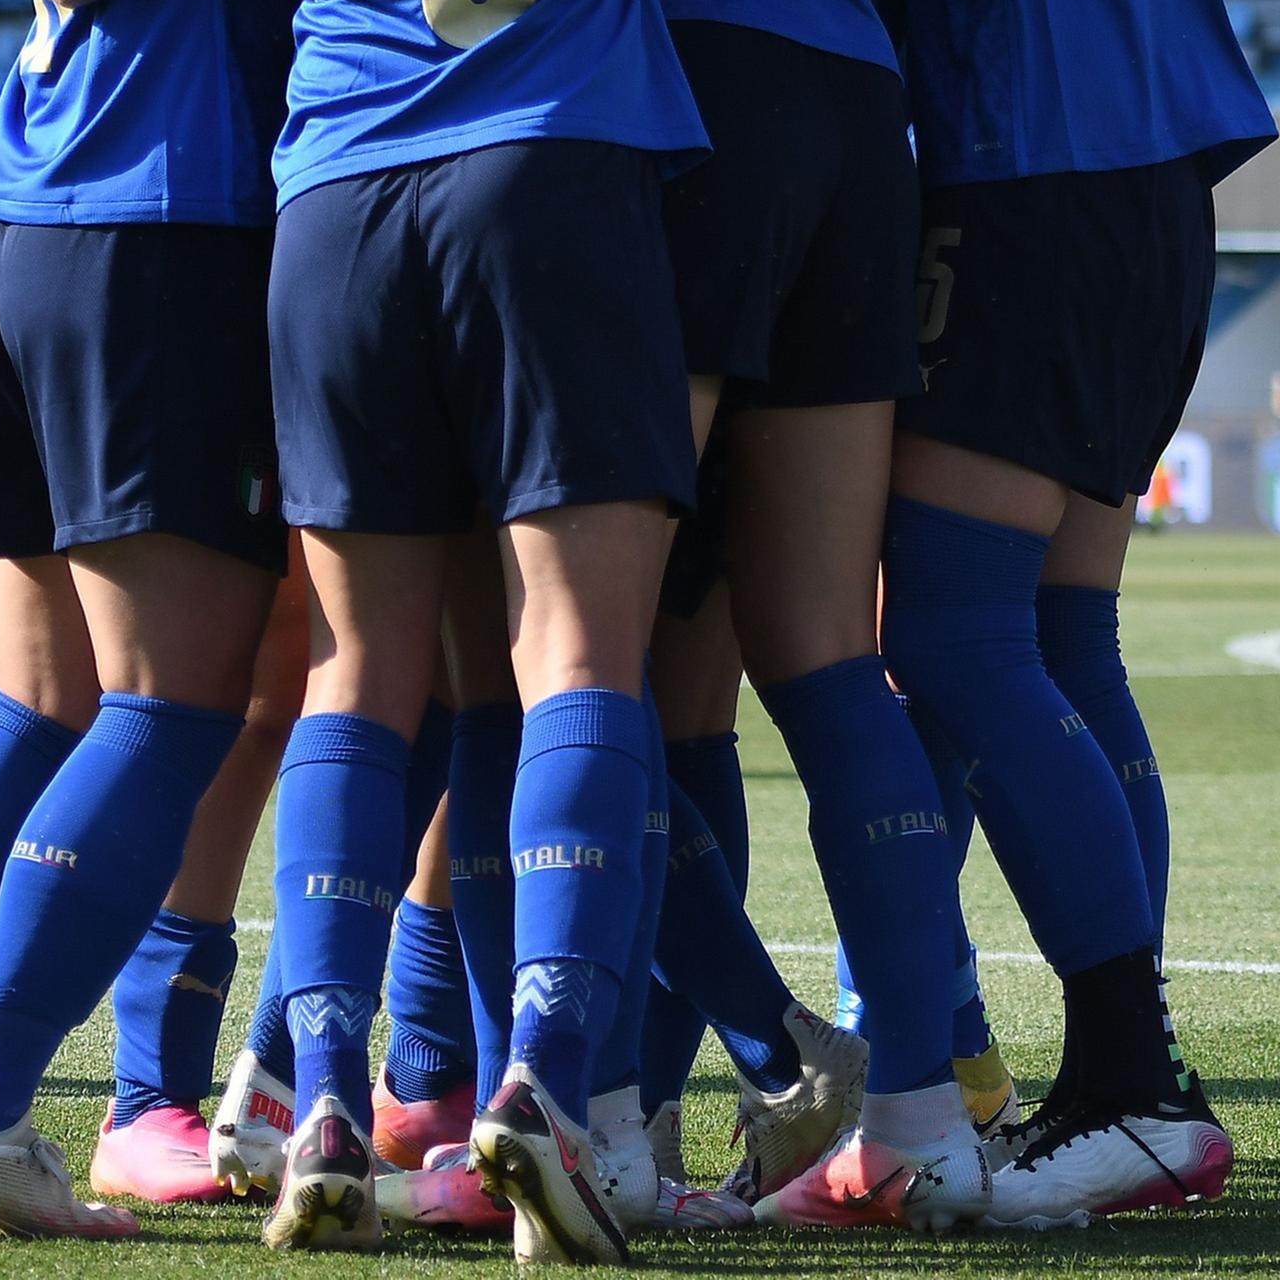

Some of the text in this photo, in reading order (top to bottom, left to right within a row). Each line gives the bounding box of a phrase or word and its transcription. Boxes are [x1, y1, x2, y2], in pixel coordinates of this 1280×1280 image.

[865, 811, 948, 840] ITALIA
[514, 846, 604, 871] ITALIA
[305, 873, 393, 912] ITALIA
